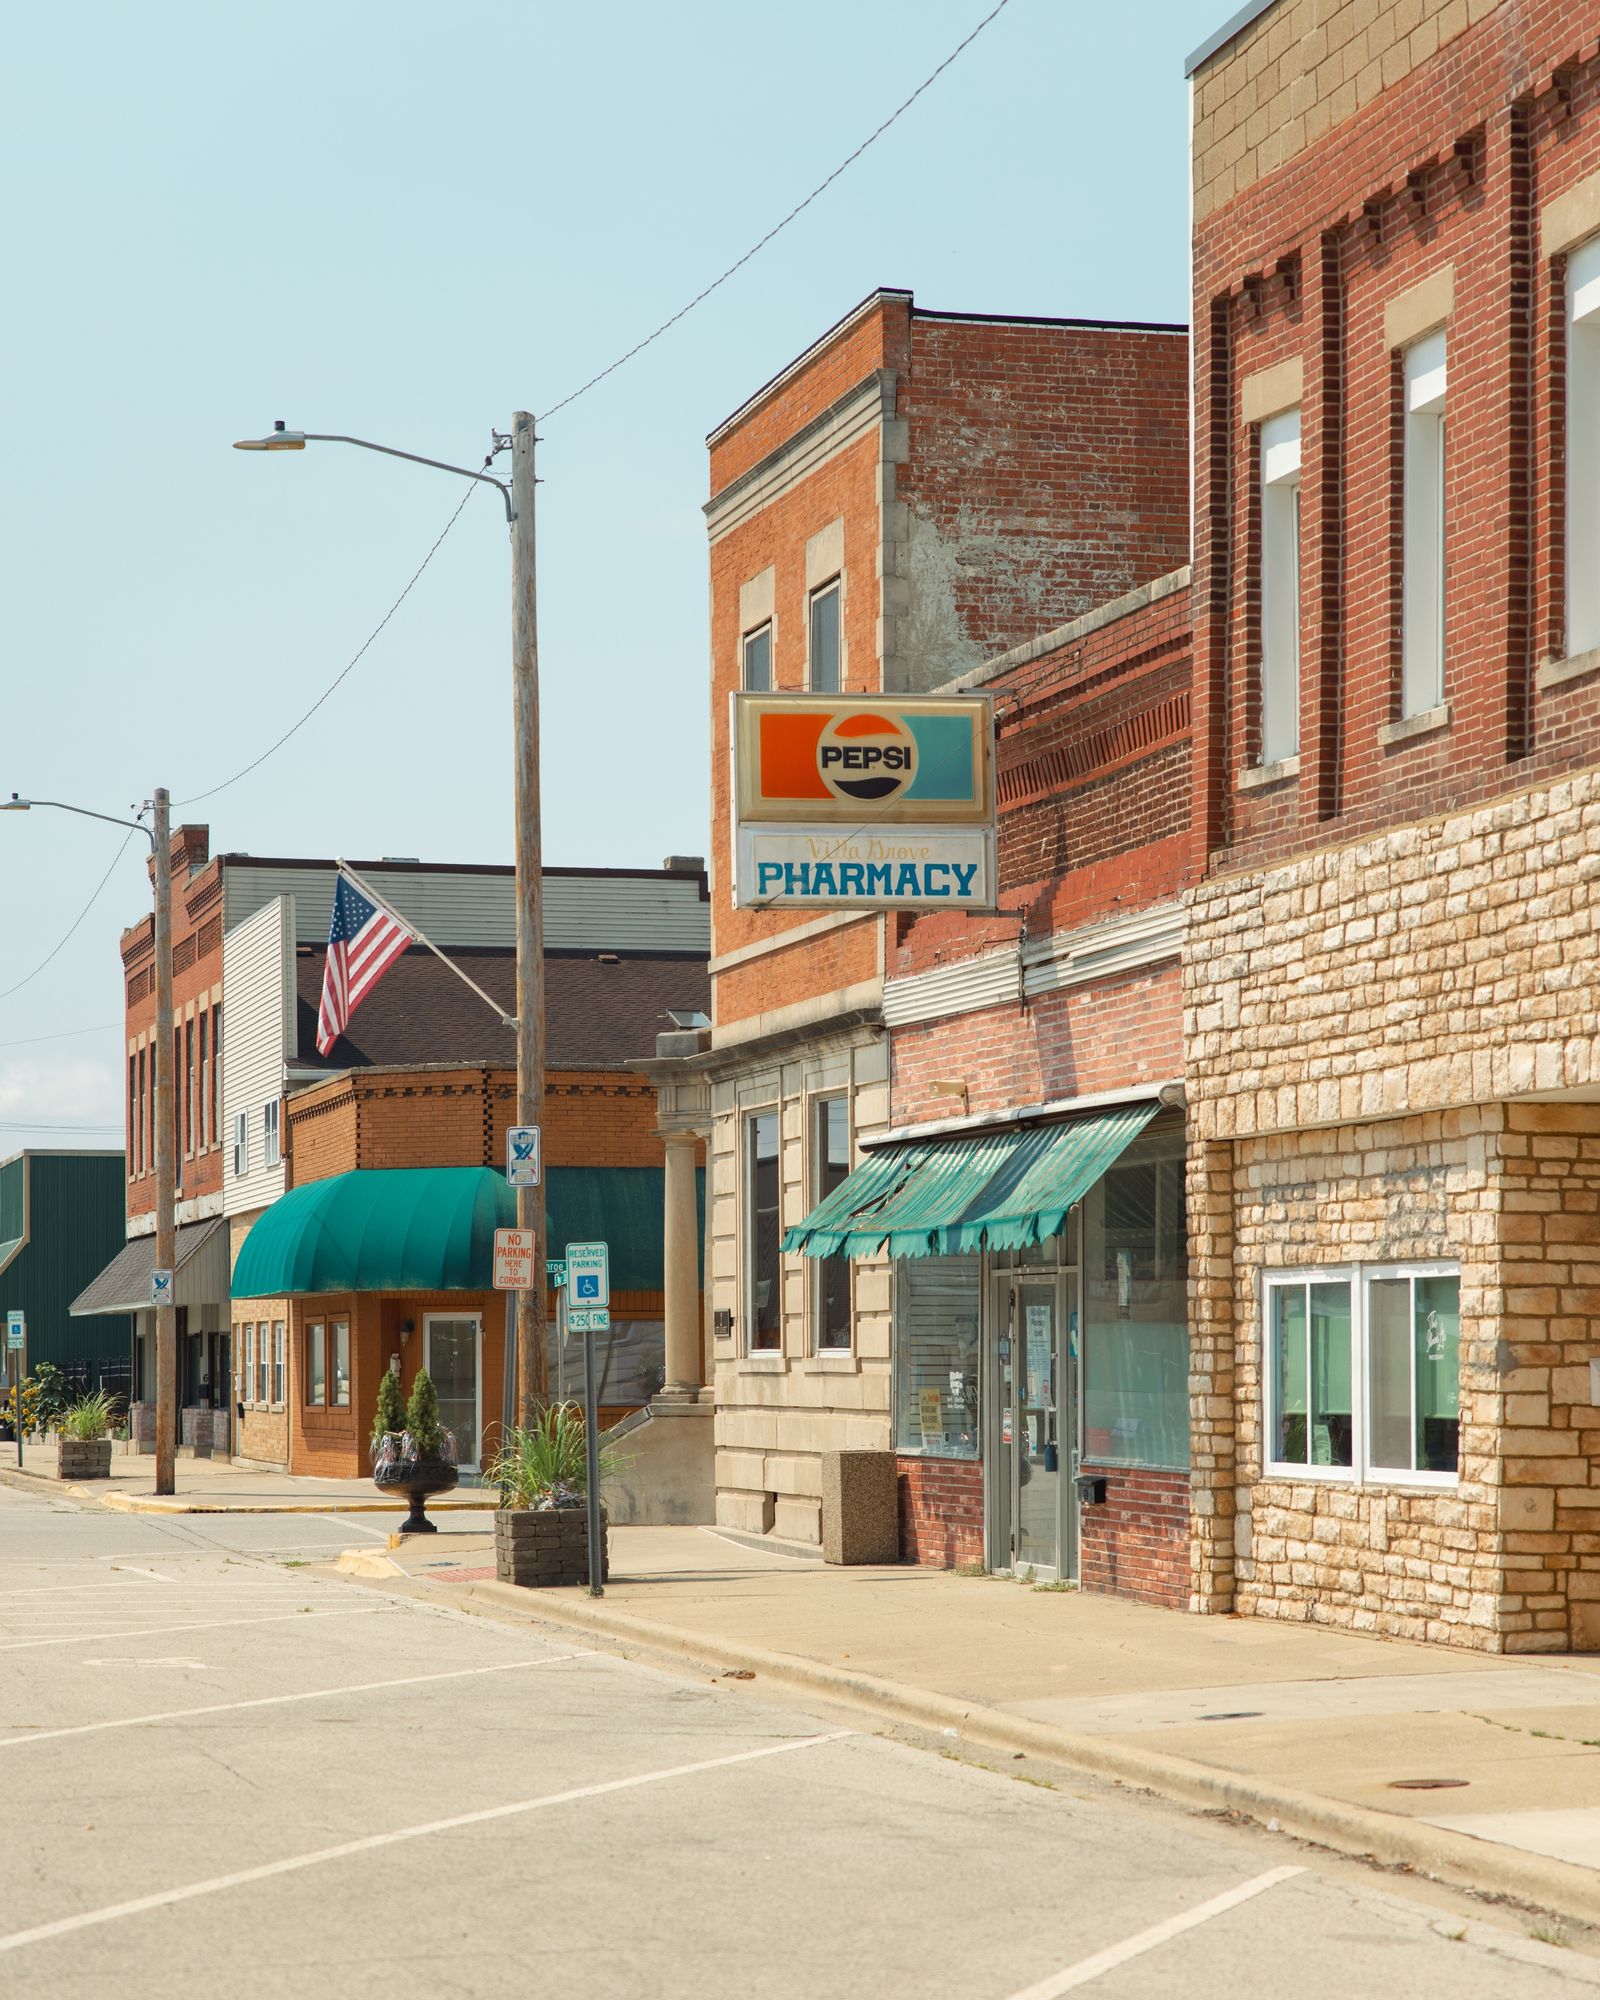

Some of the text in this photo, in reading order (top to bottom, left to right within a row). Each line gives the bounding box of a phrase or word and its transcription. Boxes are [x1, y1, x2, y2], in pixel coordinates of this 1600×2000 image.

[821, 746, 911, 770] PEPSI
[807, 837, 930, 860] Villa Grove
[758, 862, 978, 897] PHARMACY
[507, 1234, 522, 1246] NO
[497, 1247, 532, 1259] PARKING
[569, 1249, 605, 1258] RESERVED
[504, 1260, 523, 1268] HERE
[572, 1260, 603, 1269] PARKING
[509, 1268, 519, 1276] TO
[499, 1277, 528, 1285] CORNER
[593, 1313, 608, 1326] FINE
